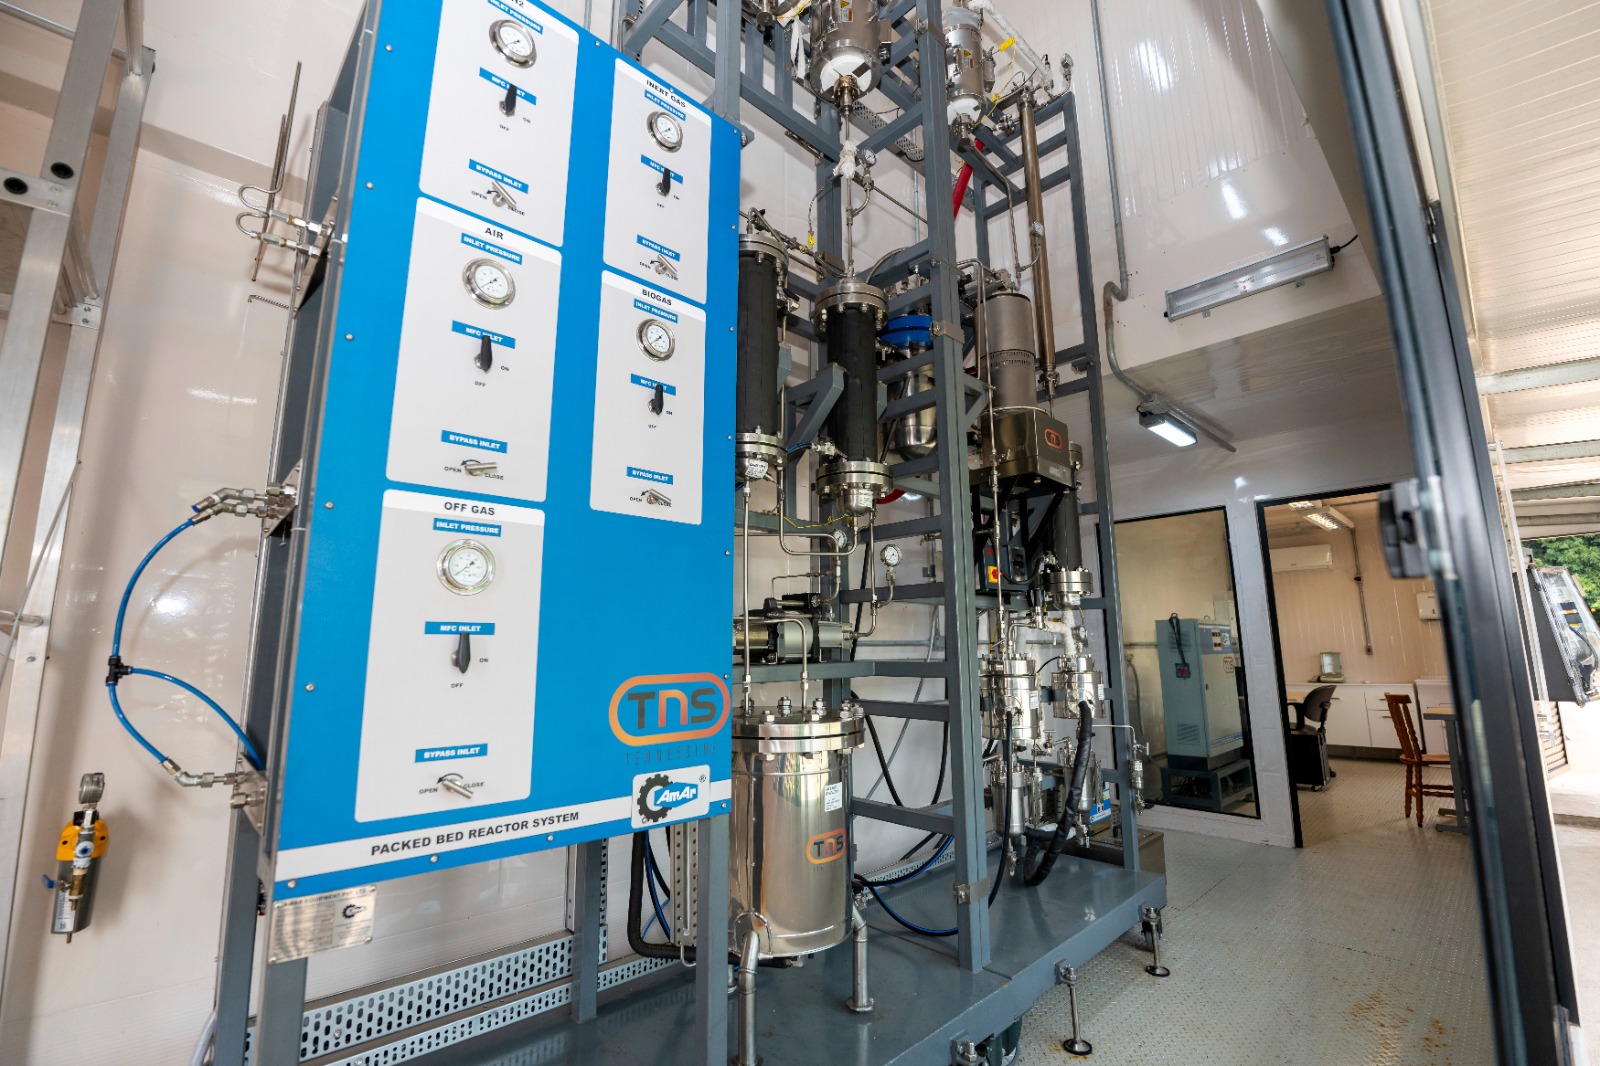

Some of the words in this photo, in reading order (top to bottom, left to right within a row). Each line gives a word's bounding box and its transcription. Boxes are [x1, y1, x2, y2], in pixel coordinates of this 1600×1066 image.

[646, 79, 669, 97] INERT
[670, 95, 686, 108] GAS
[475, 163, 503, 180] BYPASS
[503, 176, 523, 190] INLET
[471, 190, 488, 201] OPEN
[484, 227, 504, 240] AIR
[463, 235, 485, 249] INLET
[485, 243, 521, 263] PRESSURE
[642, 288, 673, 306] BIOGAS
[635, 301, 652, 312] INLET
[465, 327, 482, 336] MFC
[449, 434, 479, 446] BYPASS
[479, 440, 501, 450] INLET
[484, 472, 505, 481] CLOSE
[632, 469, 653, 479] BYPASS
[444, 501, 468, 512] OFF
[471, 504, 496, 516] GAS
[436, 521, 459, 530] INLET
[460, 523, 500, 534] PRESSURE
[440, 624, 457, 632] MFC
[423, 750, 456, 759] BYPASS
[456, 747, 481, 756] INLET
[418, 786, 439, 795] OPEN
[462, 781, 485, 789] CLOSE
[371, 836, 432, 857] PACKED
[436, 831, 465, 846] BED
[468, 819, 529, 840] REACTOR
[532, 811, 580, 828] SYSTEM
